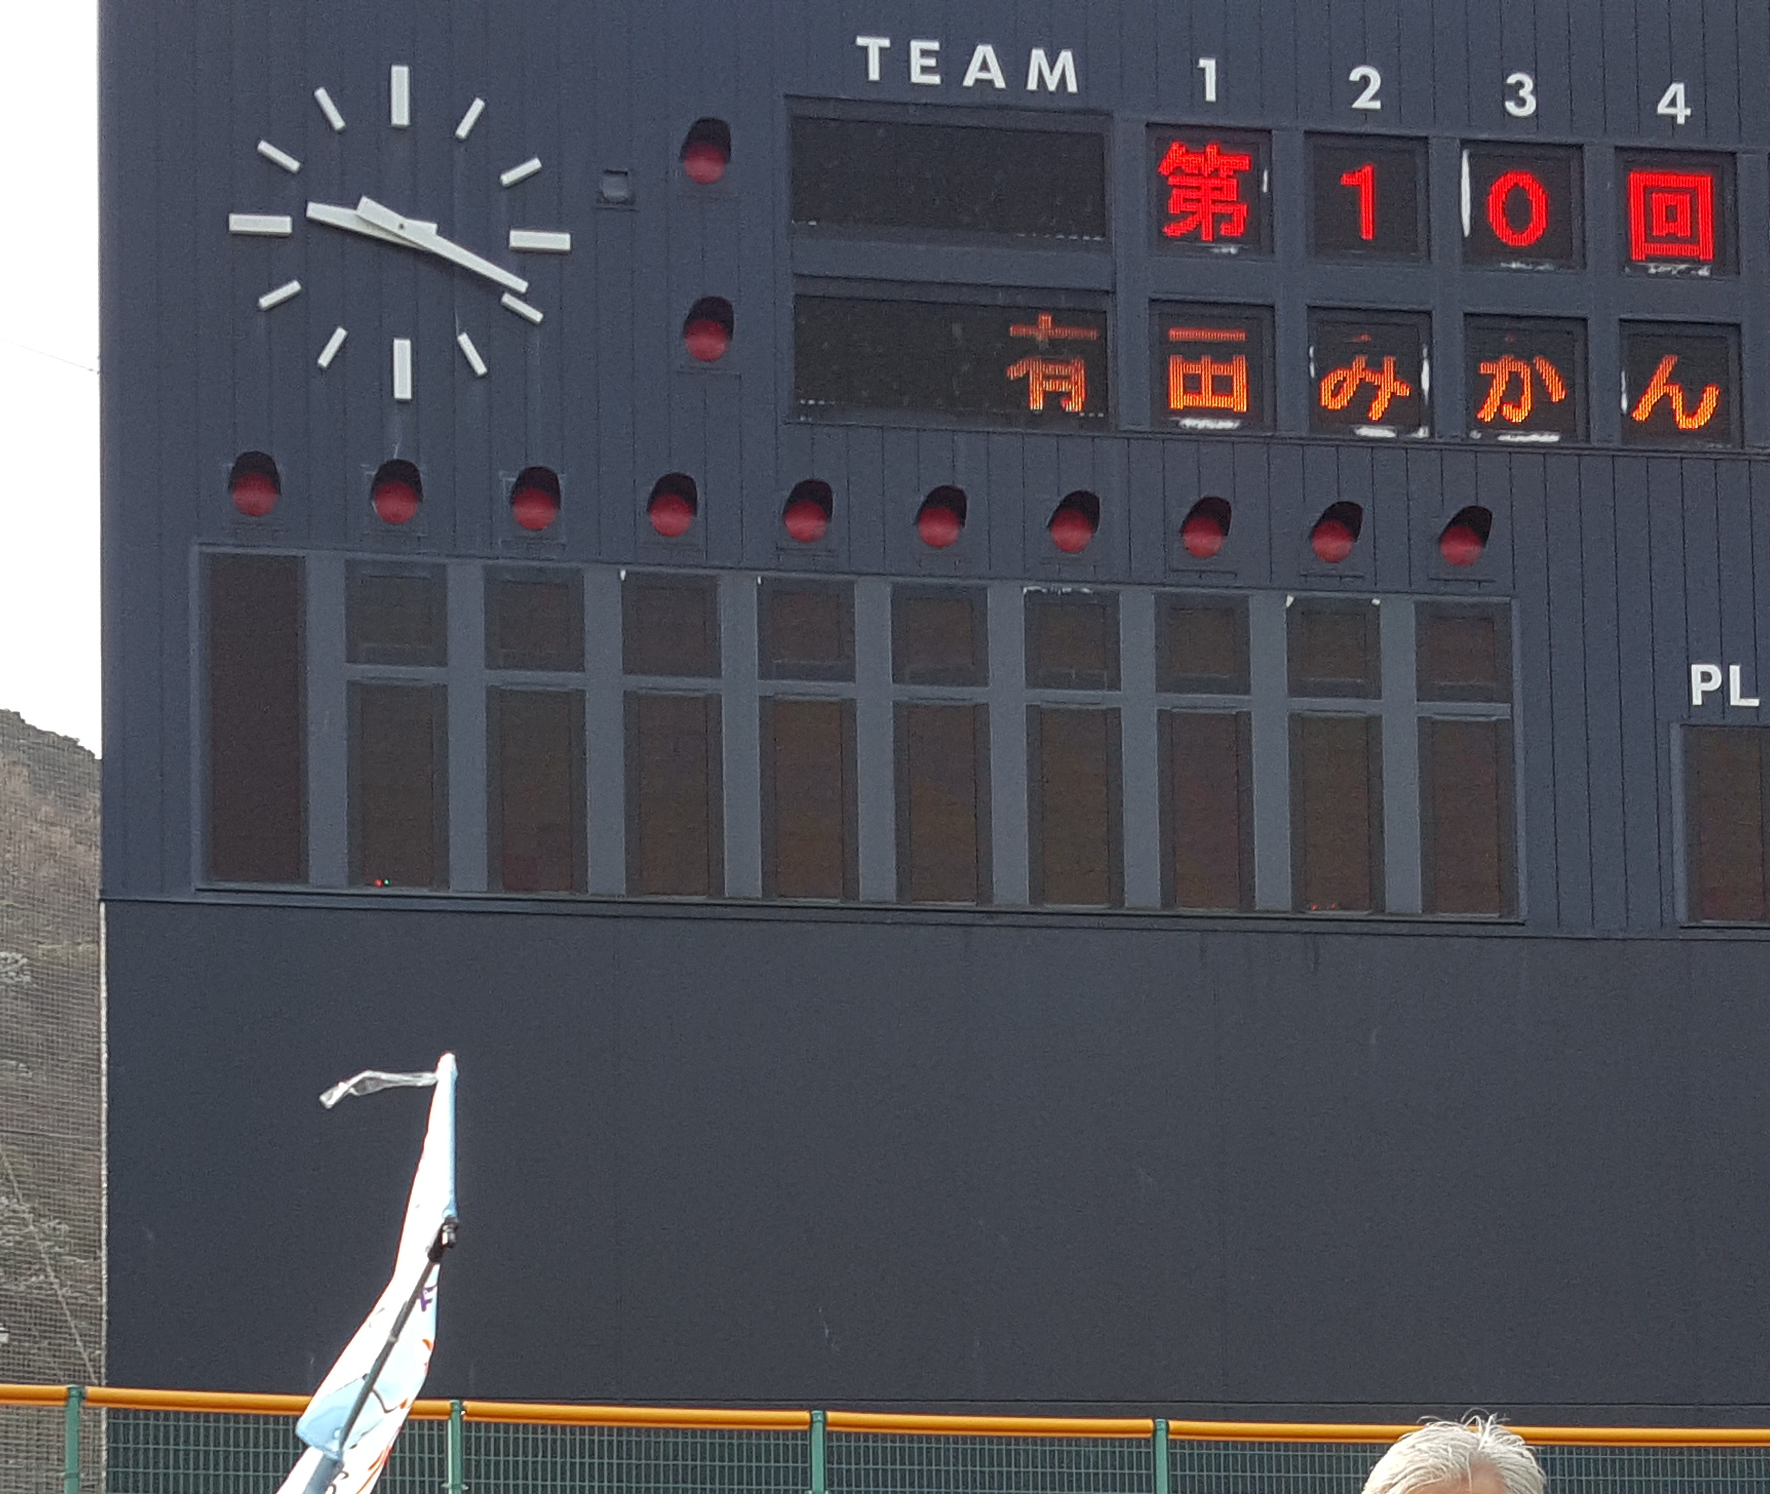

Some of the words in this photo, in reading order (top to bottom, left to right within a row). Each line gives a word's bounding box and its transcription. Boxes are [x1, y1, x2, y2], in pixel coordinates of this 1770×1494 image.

[855, 35, 1078, 93] TEAM
[1197, 57, 1217, 102] 1
[1348, 65, 1382, 110] 2
[1504, 72, 1537, 117] 3
[1656, 82, 1692, 125] 4
[1690, 663, 1760, 707] PL
